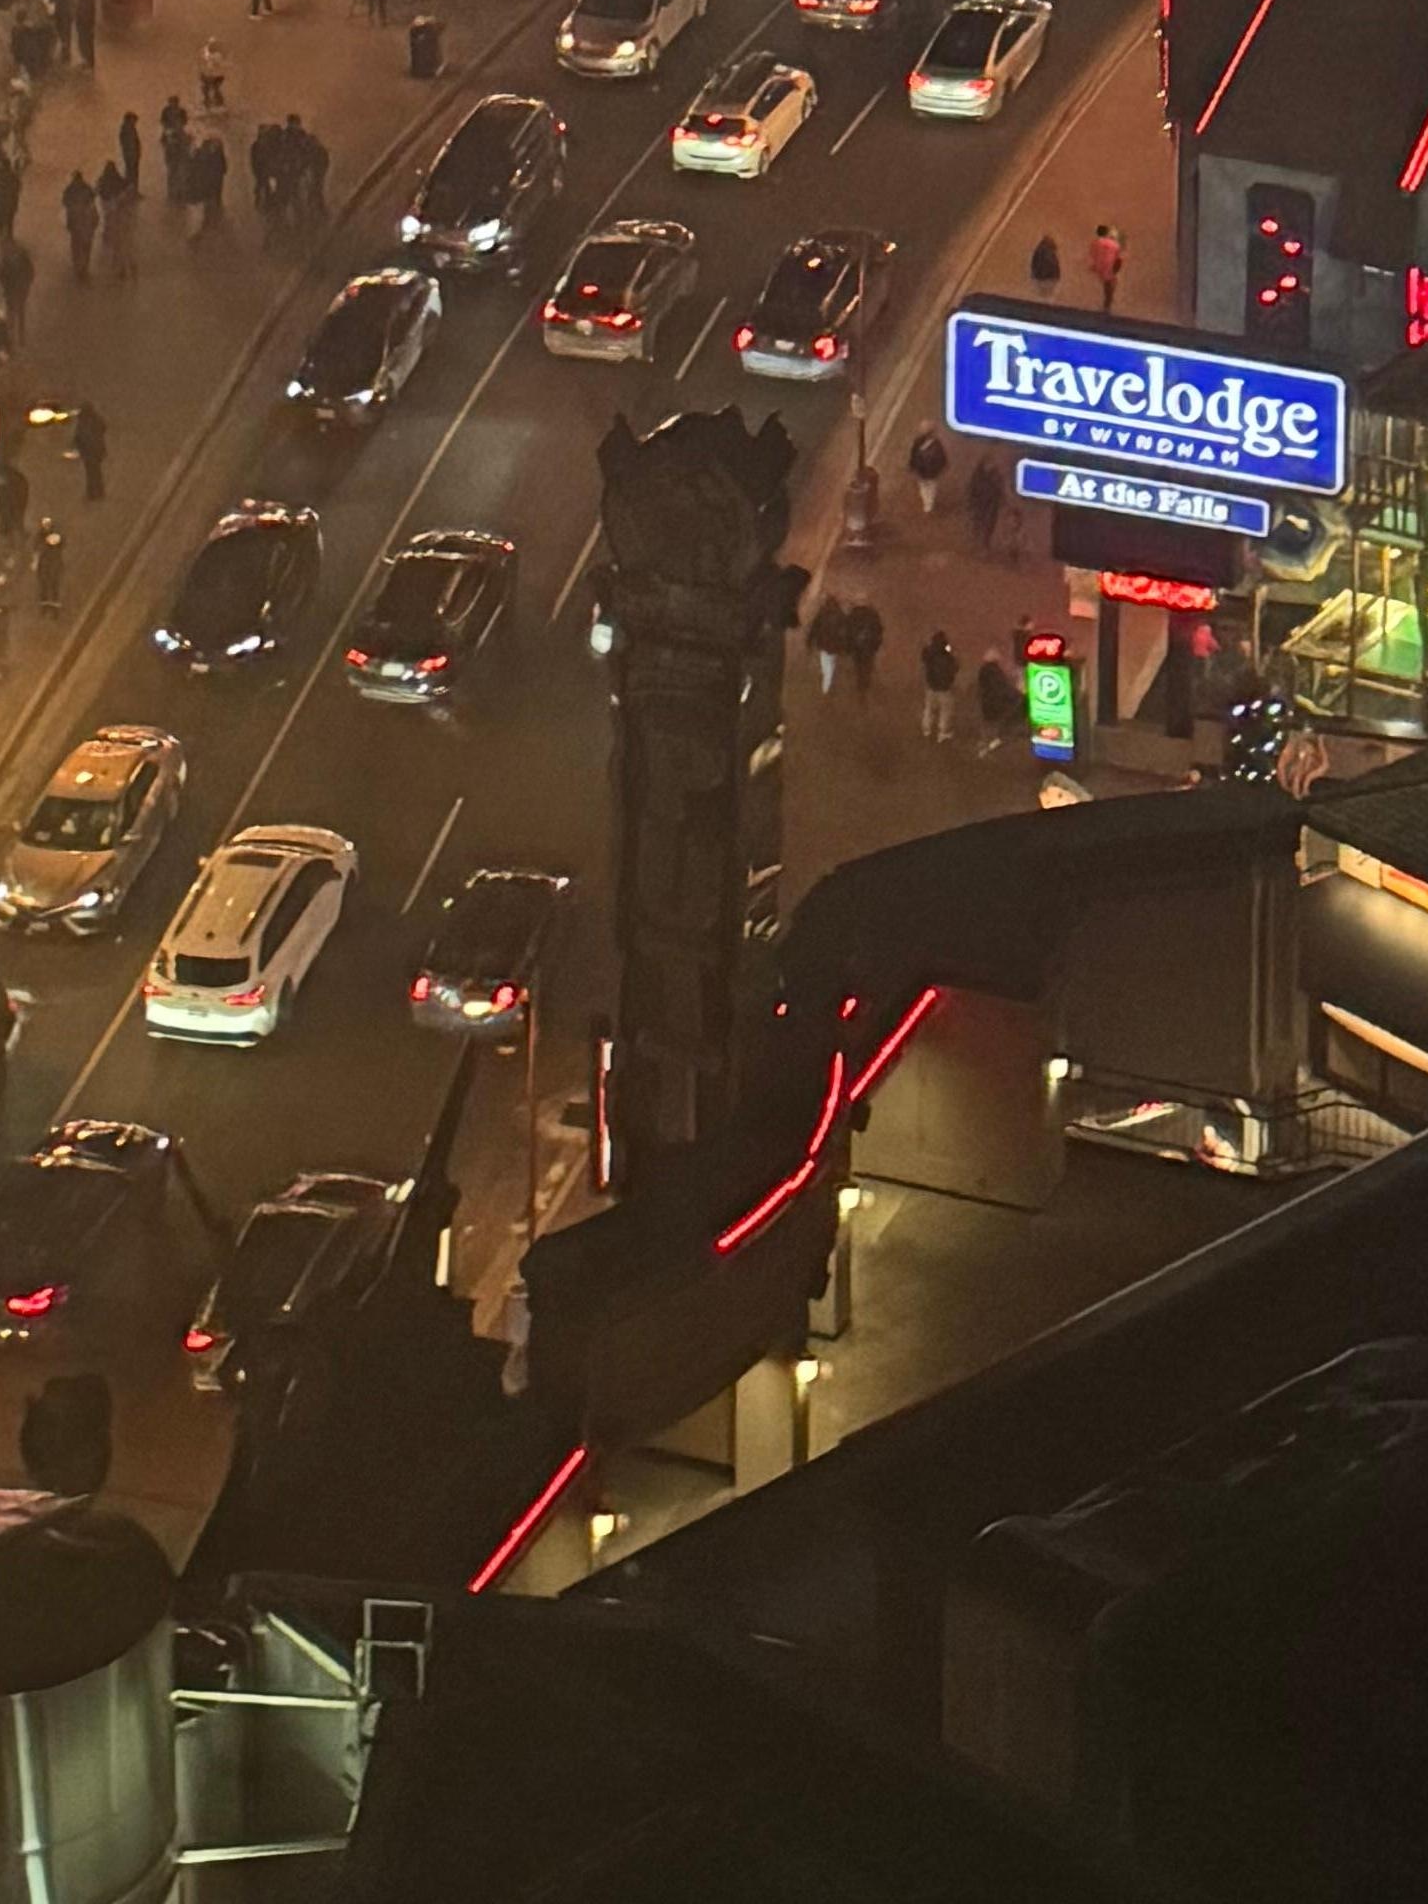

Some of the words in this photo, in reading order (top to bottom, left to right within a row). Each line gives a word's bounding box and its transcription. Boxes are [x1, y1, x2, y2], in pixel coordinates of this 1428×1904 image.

[972, 329, 1319, 458] Travelodge
[1043, 418, 1078, 438] BY
[1090, 427, 1241, 467] WYNDHAM
[1057, 472, 1097, 500] At
[1102, 480, 1153, 510] the
[1156, 488, 1229, 523] Falls
